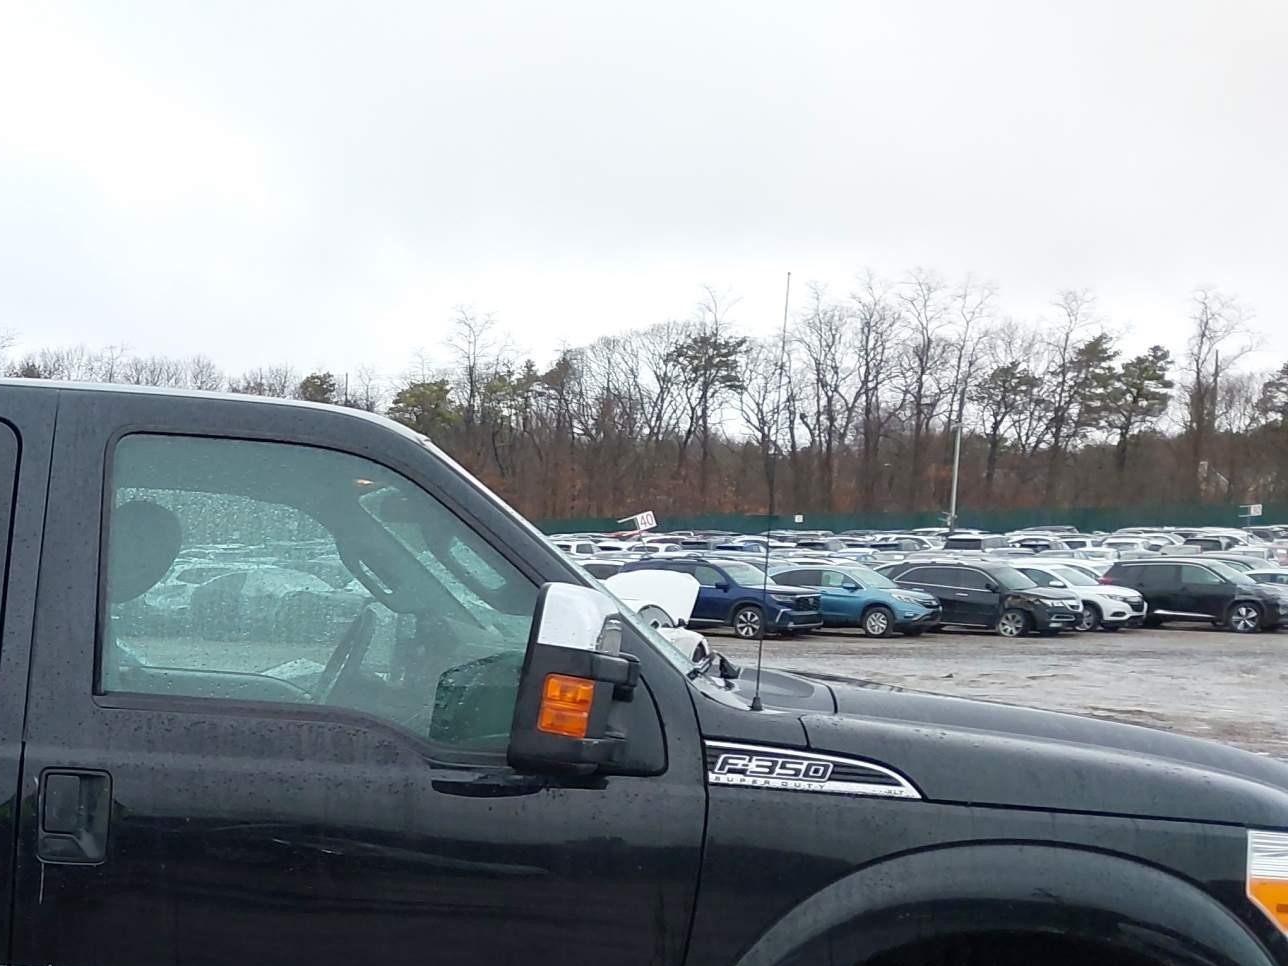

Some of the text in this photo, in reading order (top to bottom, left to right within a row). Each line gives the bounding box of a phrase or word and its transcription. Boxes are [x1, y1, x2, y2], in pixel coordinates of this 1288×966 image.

[640, 513, 653, 527] 40
[714, 754, 833, 782] F-350
[714, 776, 826, 790] SUPER DUTY
